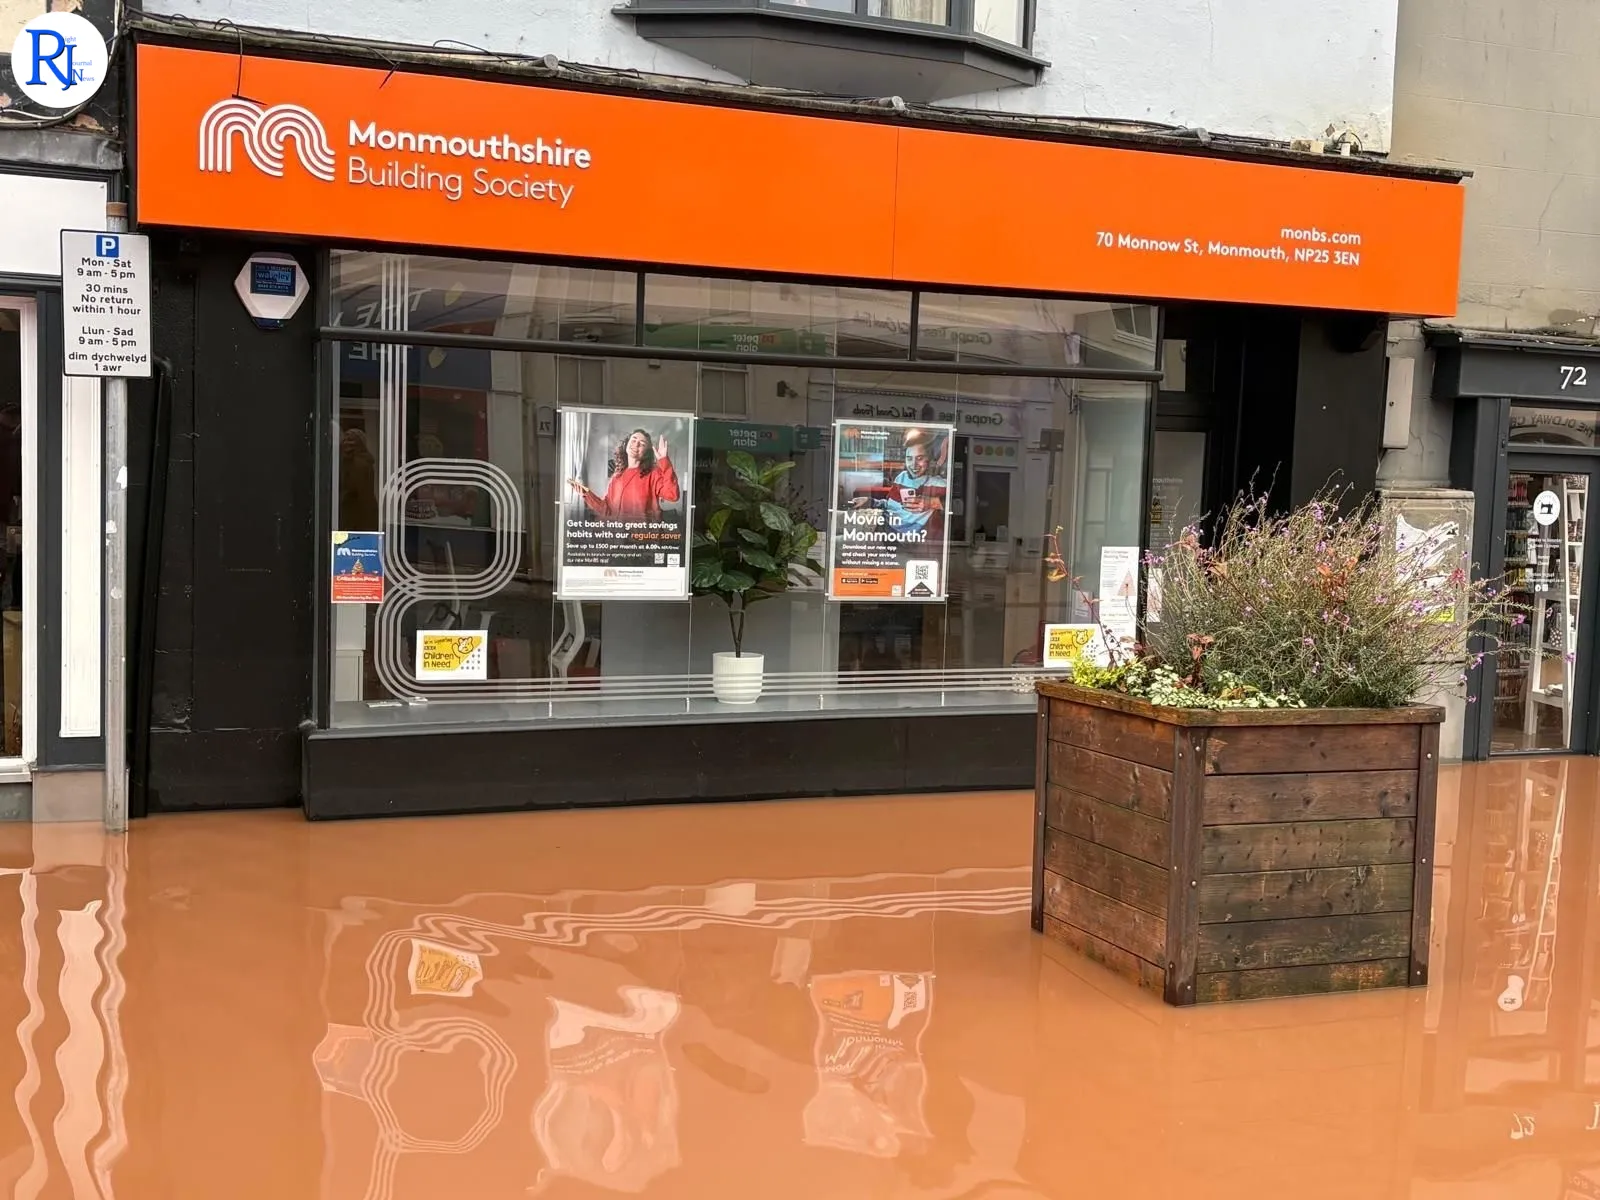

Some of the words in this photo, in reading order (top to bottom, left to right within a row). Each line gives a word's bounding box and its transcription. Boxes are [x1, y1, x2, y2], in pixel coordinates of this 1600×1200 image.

[349, 119, 592, 169] Monmouthshire
[348, 155, 462, 201] Building
[473, 167, 575, 209] Society
[1280, 226, 1361, 245] monbs.com
[1096, 231, 1113, 248] 70
[1118, 233, 1180, 253] Monnow
[1183, 238, 1204, 256] St,
[1208, 241, 1290, 263] Monmouth,
[1294, 248, 1330, 264] NP25
[1333, 250, 1360, 266] 3EN
[81, 257, 105, 267] Mon
[113, 259, 132, 268] Sat
[86, 269, 102, 277] am
[120, 271, 136, 280] pm
[85, 284, 101, 293] 30
[103, 285, 128, 294] mins
[81, 294, 97, 303] No
[100, 296, 134, 304] return
[72, 305, 106, 314] within
[109, 306, 113, 314] 1
[117, 306, 142, 315] hour
[82, 326, 105, 335] Llun
[113, 327, 134, 336] Sad
[87, 338, 104, 346] am
[121, 340, 137, 348] pm
[68, 352, 88, 360] dim
[92, 353, 147, 364] dychwelyd
[94, 363, 98, 371] 1
[103, 364, 122, 372] awr
[1560, 366, 1587, 390] 72
[844, 511, 885, 526] Movie
[889, 512, 902, 526] in
[566, 520, 582, 528] Get
[584, 520, 604, 528] back
[606, 520, 623, 528] into
[625, 521, 646, 530] great
[648, 521, 678, 531] savings
[566, 530, 592, 538] habits
[594, 530, 614, 538] with
[631, 532, 658, 540] regular
[843, 527, 928, 543] Monmouth?
[424, 652, 454, 660] Children
